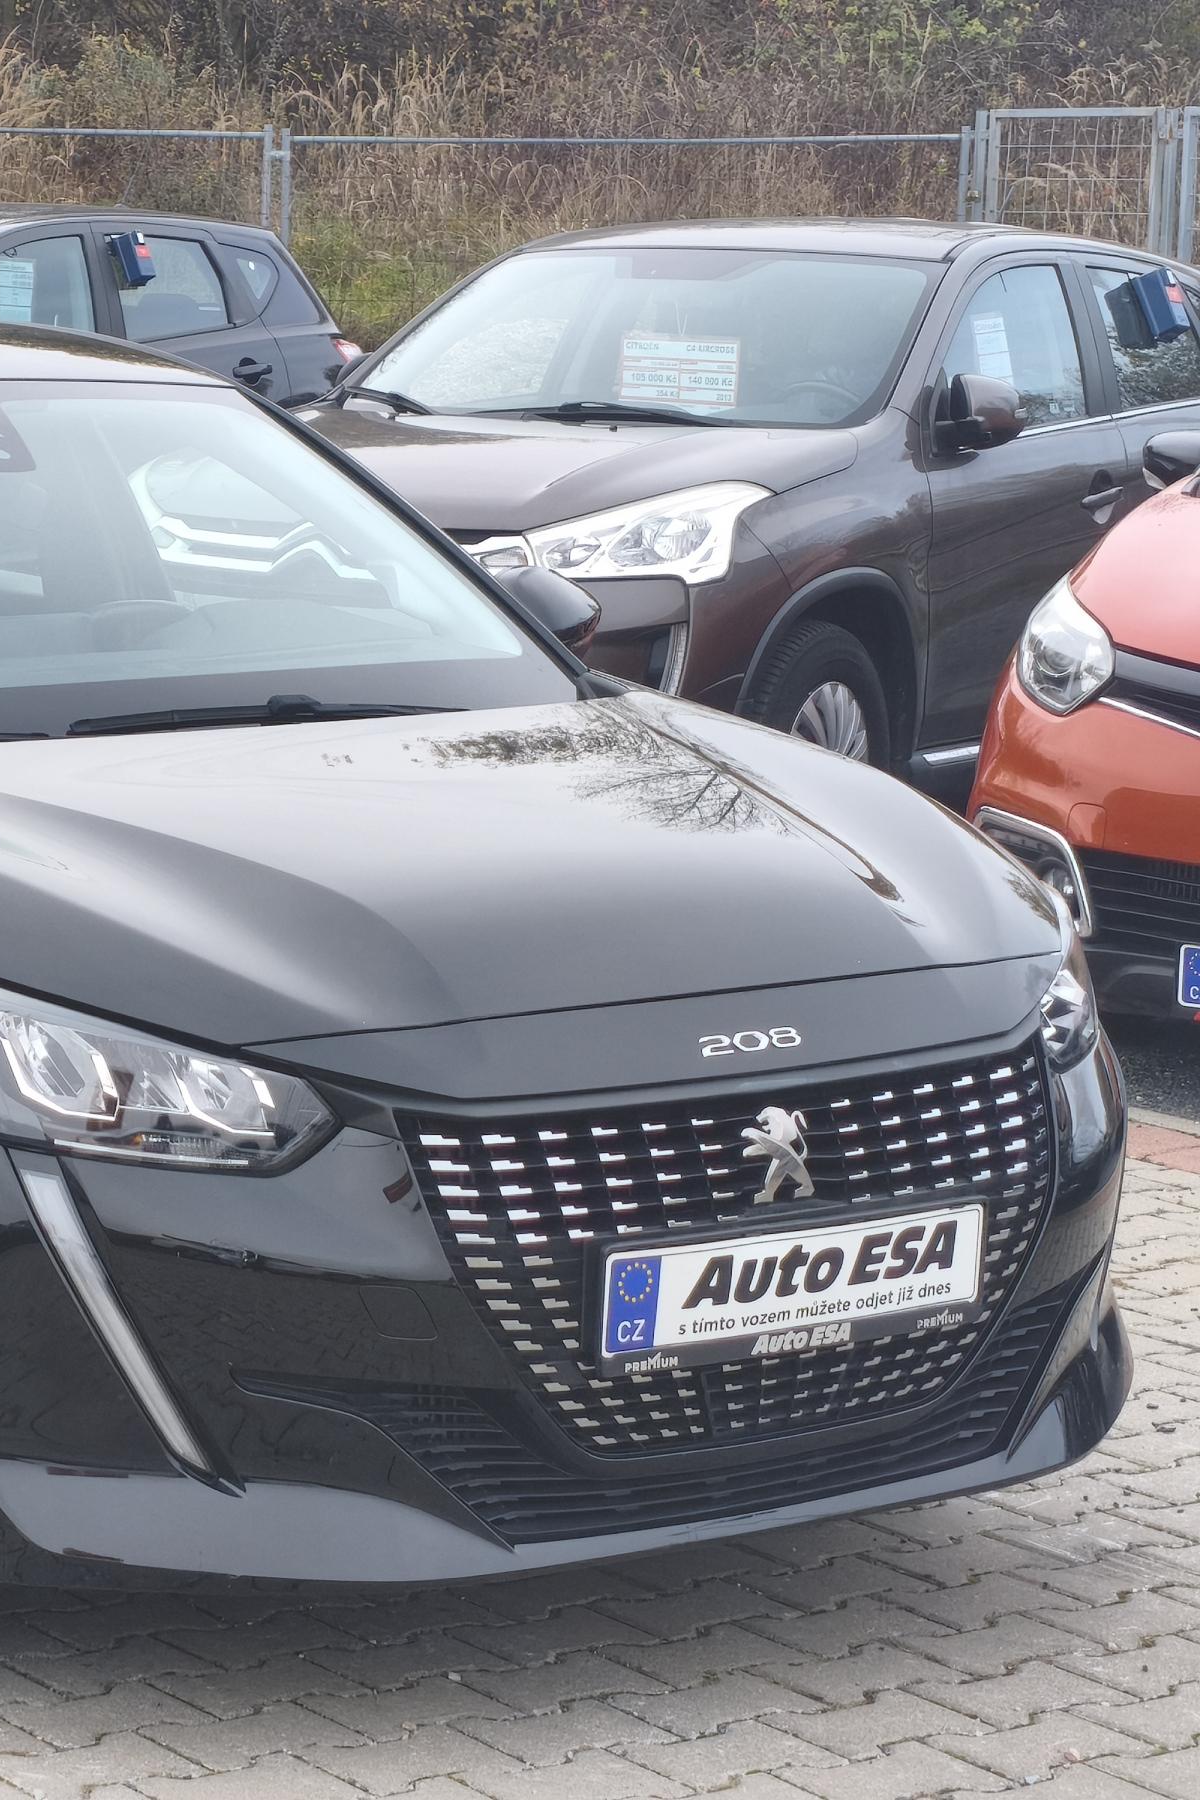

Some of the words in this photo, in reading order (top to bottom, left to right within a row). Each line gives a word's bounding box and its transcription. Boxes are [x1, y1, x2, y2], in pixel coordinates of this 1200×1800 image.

[688, 376, 702, 385] 140
[704, 377, 719, 387] 000
[1189, 985, 1200, 1000] C
[698, 1026, 802, 1058] 208
[681, 1243, 844, 1310] Auto
[847, 1219, 958, 1287] ESA
[678, 1323, 686, 1335] s
[692, 1315, 735, 1334] tímto
[741, 1309, 790, 1328] vozem
[795, 1298, 851, 1319] můžete
[855, 1292, 893, 1310] odjet
[896, 1284, 914, 1306] již
[917, 1281, 951, 1298] dnes
[916, 1307, 964, 1330] PREMIUM
[617, 1318, 646, 1343] CZ
[751, 1326, 809, 1356] Auto
[809, 1322, 852, 1347] ESA
[624, 1351, 679, 1374] PREMIUM
